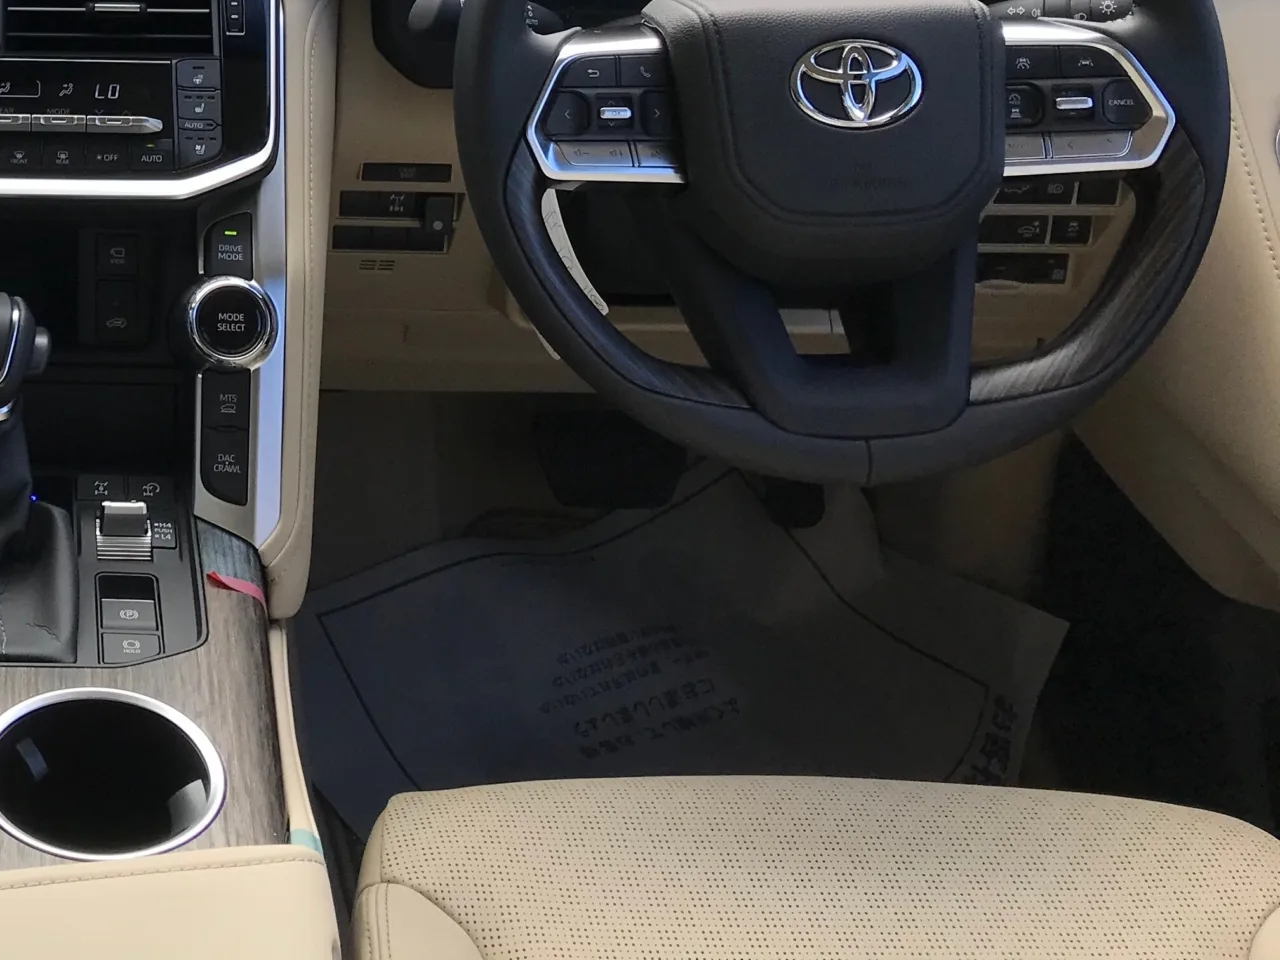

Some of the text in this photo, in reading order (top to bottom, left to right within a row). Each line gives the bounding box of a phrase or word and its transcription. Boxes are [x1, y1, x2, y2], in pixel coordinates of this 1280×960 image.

[95, 83, 120, 99] LO
[140, 155, 163, 163] AUTO
[218, 244, 242, 253] DRIVE
[218, 252, 244, 261] MODE
[218, 313, 244, 322] MODE
[217, 323, 245, 333] SELECT
[219, 394, 237, 403] MTS
[218, 454, 235, 463] DAC
[213, 464, 241, 473] CRAWL
